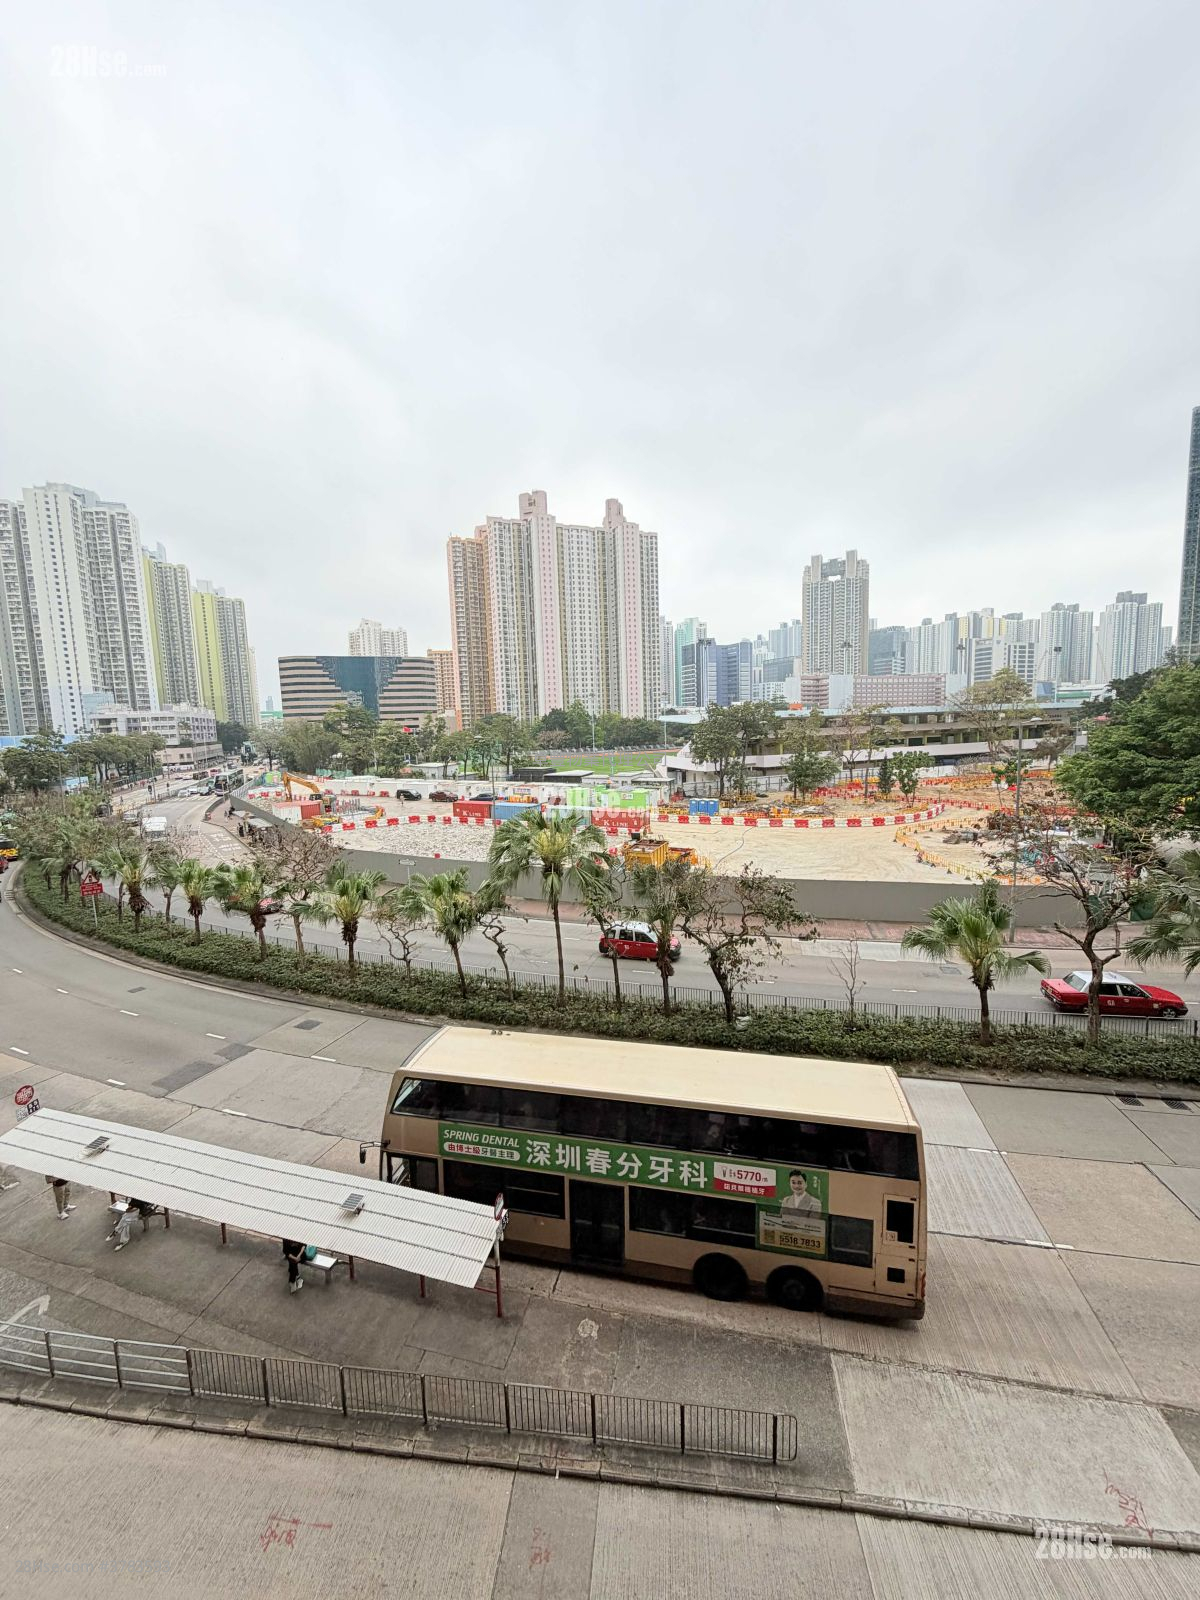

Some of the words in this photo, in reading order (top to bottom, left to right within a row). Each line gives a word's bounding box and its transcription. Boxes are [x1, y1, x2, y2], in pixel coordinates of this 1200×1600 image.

[443, 1129, 480, 1142] SPRING
[481, 1134, 520, 1148] DENTAL
[525, 1139, 708, 1189] 深圳春分牙科
[737, 1169, 761, 1182] 5770
[800, 1237, 821, 1249] 7833
